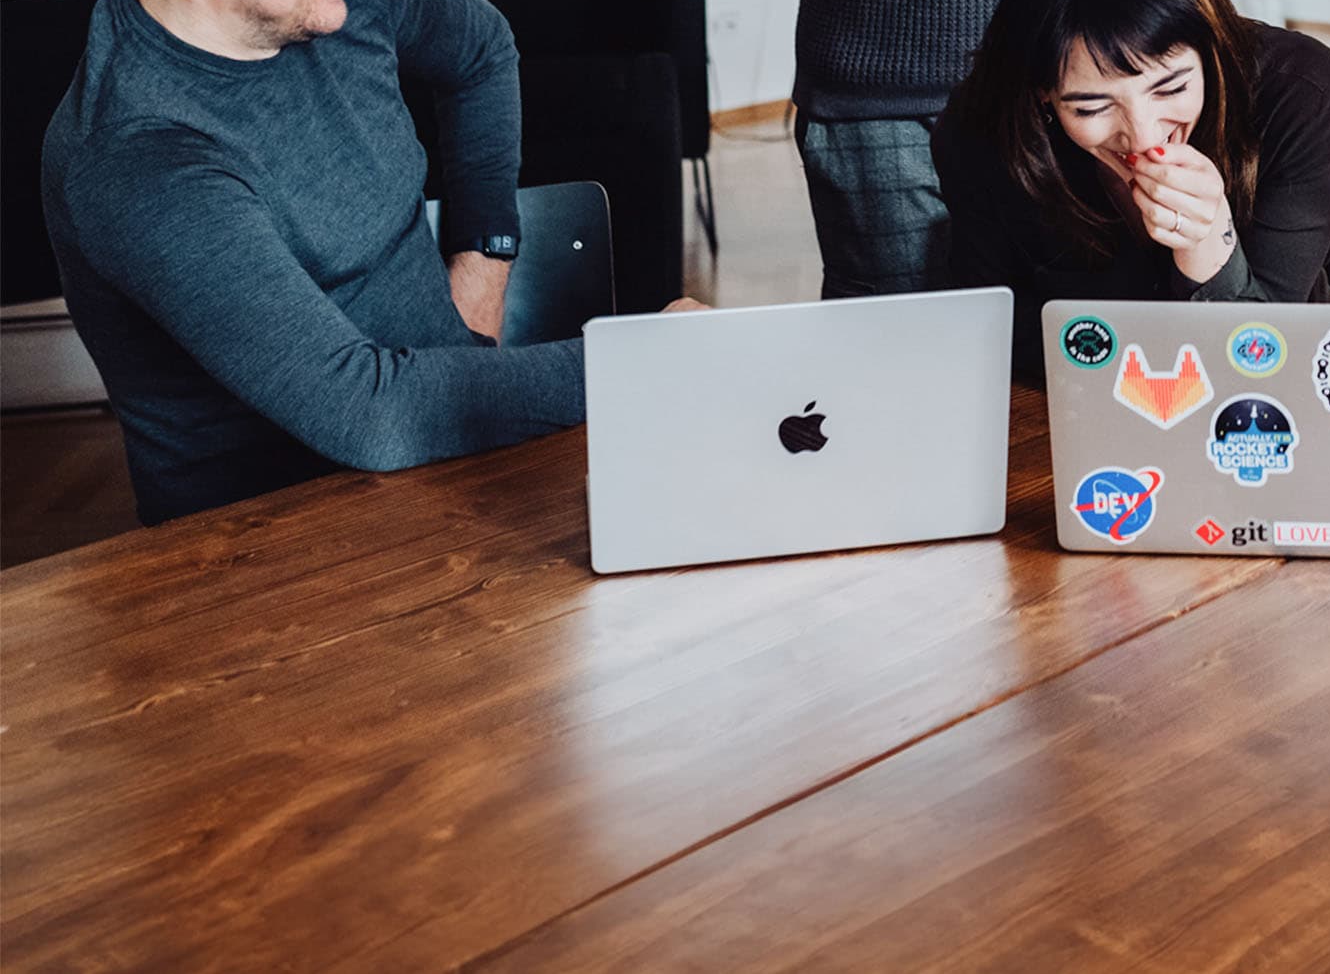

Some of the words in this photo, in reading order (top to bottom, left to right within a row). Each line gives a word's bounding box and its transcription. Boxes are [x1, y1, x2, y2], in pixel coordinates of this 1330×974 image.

[1213, 442, 1277, 456] ROCKET
[1221, 455, 1287, 468] SCIENCE
[1093, 492, 1139, 519] DEV
[1231, 521, 1268, 546] git
